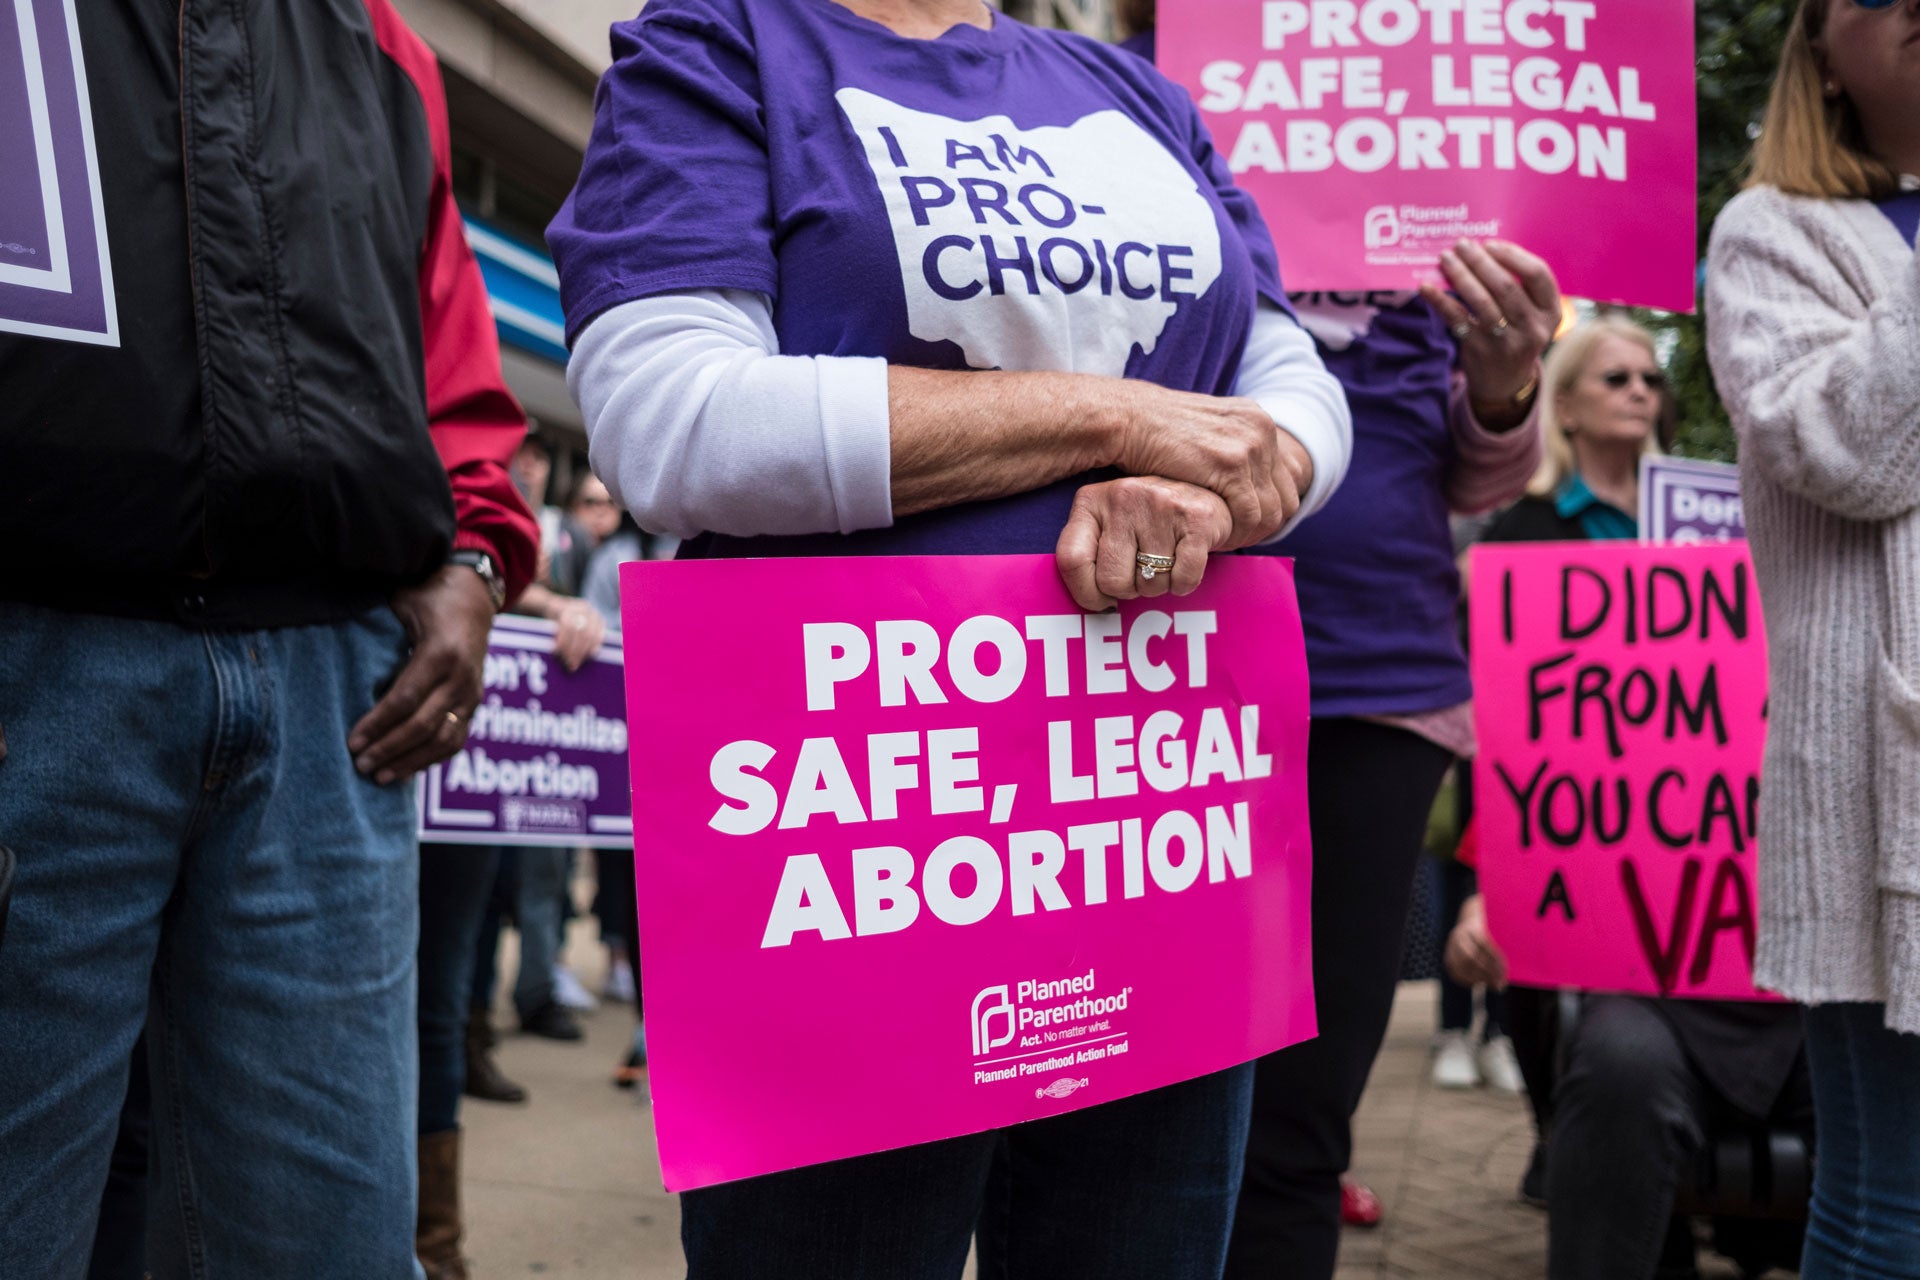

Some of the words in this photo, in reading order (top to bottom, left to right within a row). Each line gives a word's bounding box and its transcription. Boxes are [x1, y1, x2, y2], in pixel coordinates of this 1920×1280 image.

[1262, 0, 1596, 51] PROTECT
[1199, 55, 1410, 114] SAFE,
[1431, 54, 1657, 121] LEGAL
[877, 126, 908, 168] I
[945, 134, 1055, 178] AM
[1228, 117, 1628, 181] ABORTION
[899, 176, 1106, 229] PRO-
[922, 234, 1197, 301] CHOICE
[1673, 487, 1745, 528] Don
[1501, 569, 1514, 643] I
[1558, 562, 1748, 644] DIDN
[483, 650, 547, 694] on't
[802, 610, 1218, 711] PROTECT
[470, 694, 628, 754] riminalize
[1528, 650, 1728, 757] FROM
[446, 748, 600, 801] Abortion
[707, 726, 1018, 836] SAFE,
[1048, 705, 1273, 804] LEGAL
[1493, 760, 1631, 848] YOU
[760, 801, 1253, 949] ABORTION
[1536, 869, 1576, 920] A
[1620, 857, 1755, 993] VA
[1017, 968, 1095, 1004] Planned
[974, 1065, 1017, 1085] Planned
[1019, 1052, 1074, 1076] Parenthood
[1076, 1046, 1105, 1064] Action
[1107, 1040, 1129, 1056] Fund
[1020, 1035, 1042, 1048] Act.
[1044, 1031, 1058, 1042] No
[1059, 1026, 1087, 1040] matter
[1088, 1019, 1111, 1033] what.
